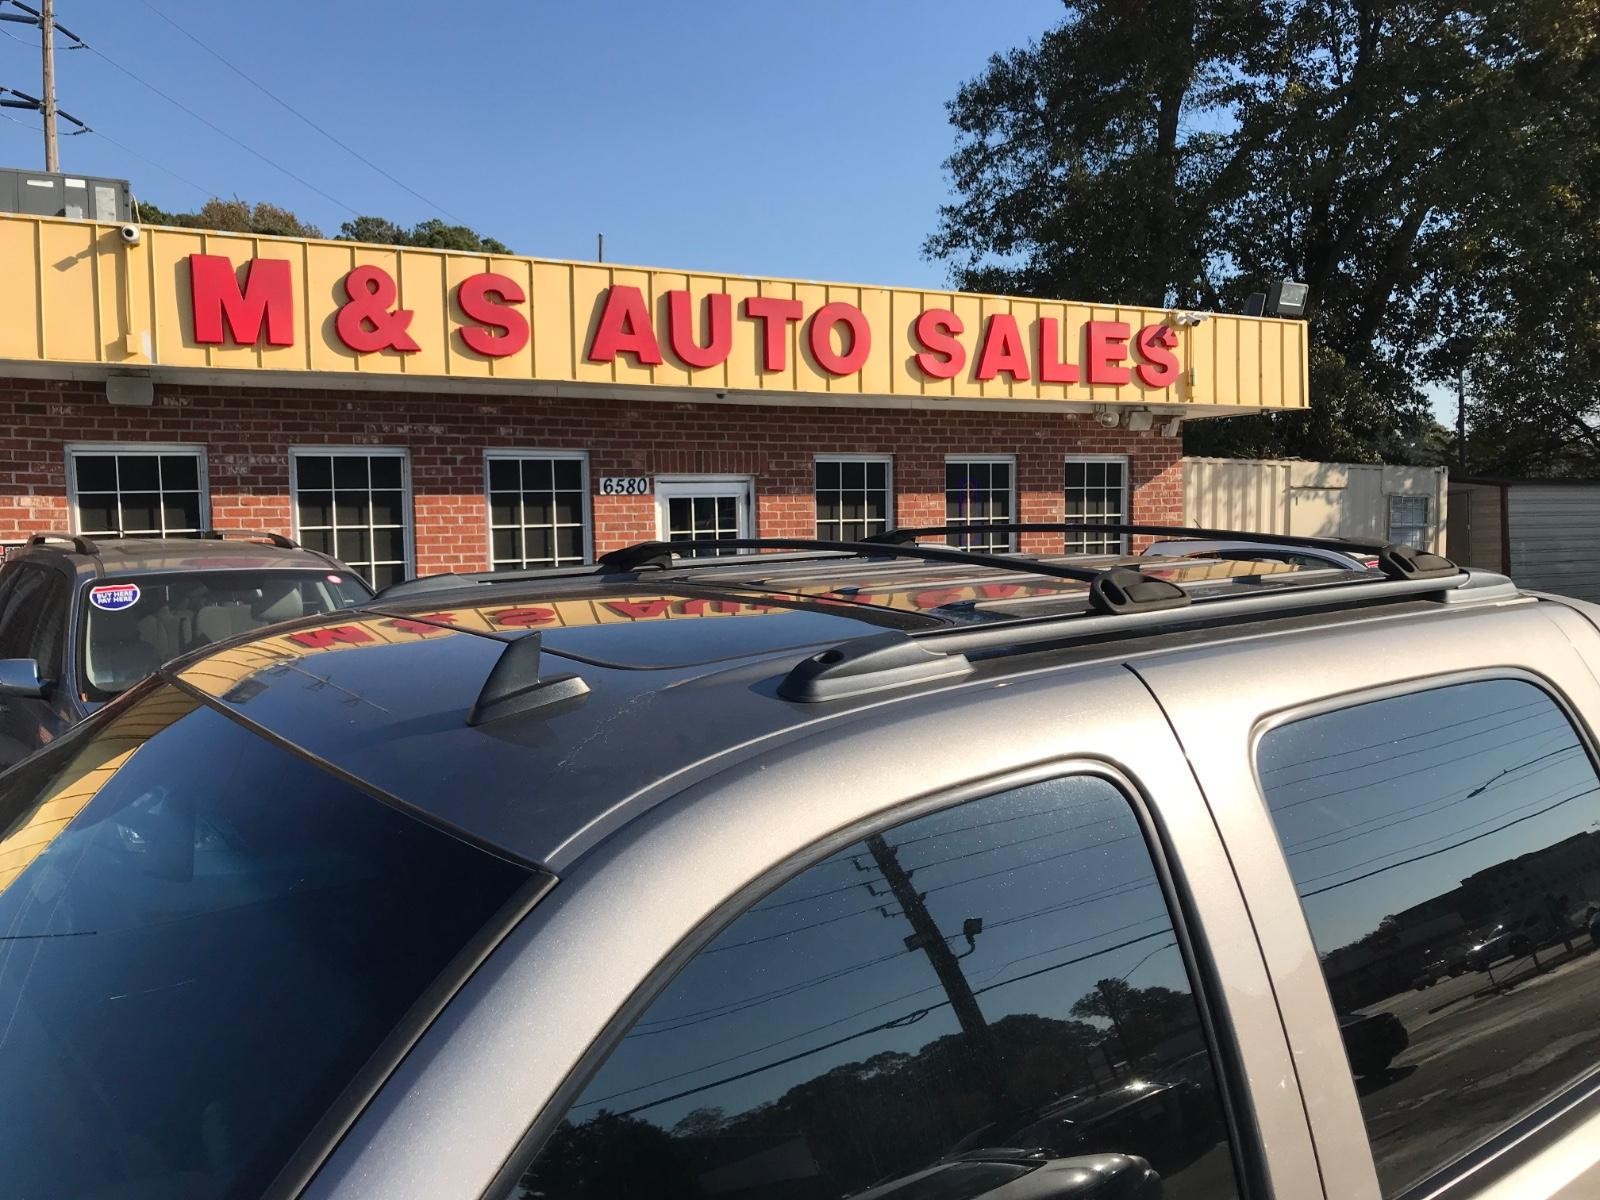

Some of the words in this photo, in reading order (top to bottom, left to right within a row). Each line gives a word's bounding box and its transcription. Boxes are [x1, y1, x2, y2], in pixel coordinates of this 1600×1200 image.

[188, 252, 294, 348] M
[335, 264, 422, 355] &
[457, 271, 530, 359] S
[588, 284, 871, 377] AUTO
[914, 308, 1181, 390] SALES
[603, 478, 648, 495] 6580
